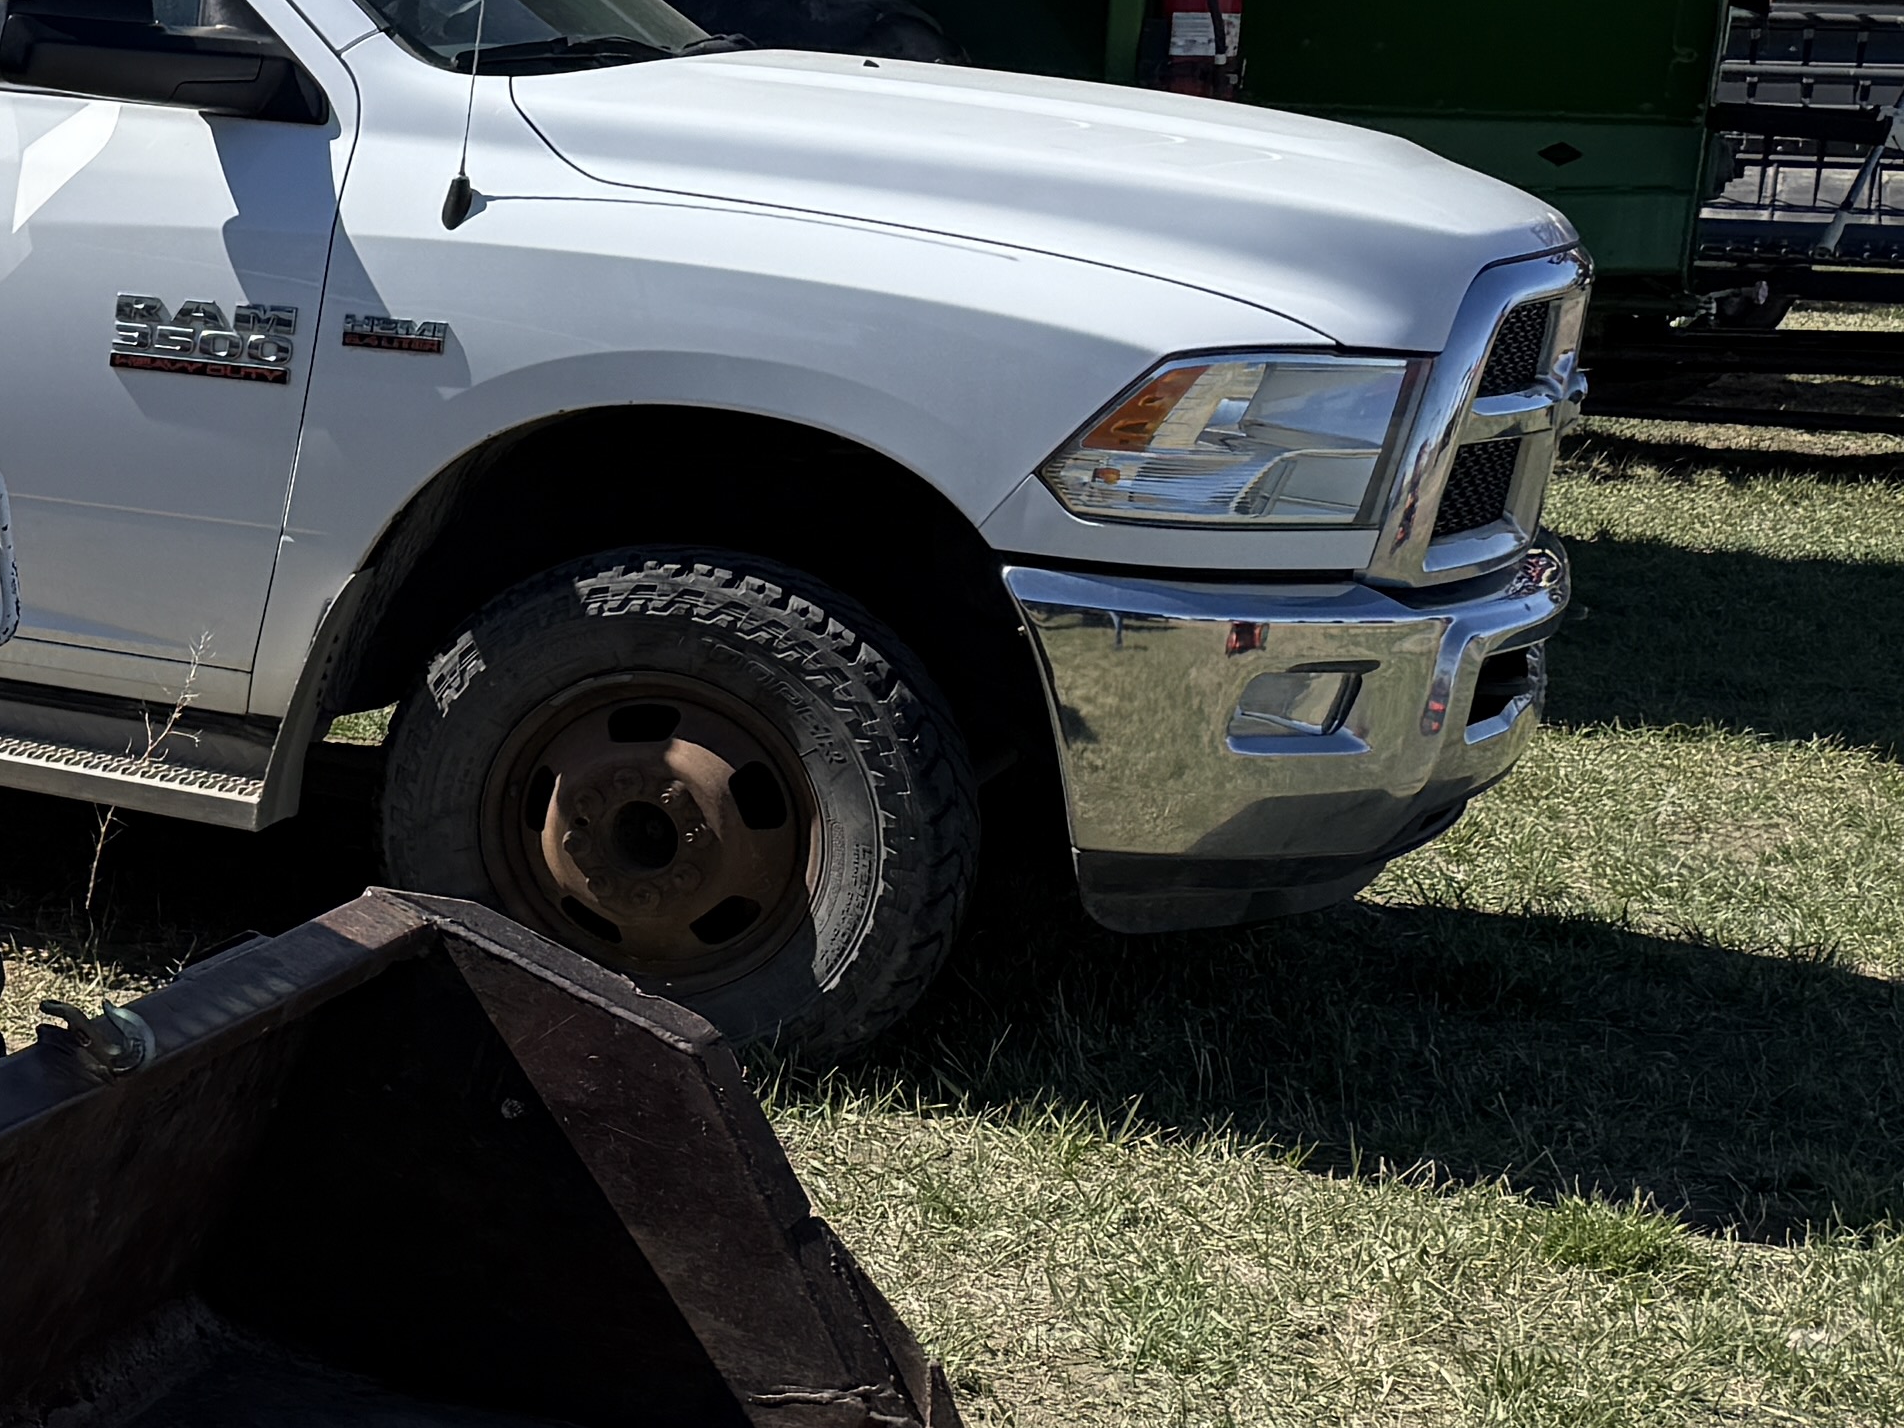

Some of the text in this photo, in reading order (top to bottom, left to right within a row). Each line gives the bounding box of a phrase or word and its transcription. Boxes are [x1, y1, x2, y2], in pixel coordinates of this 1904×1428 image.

[114, 291, 299, 336] RAM
[343, 313, 449, 339] HEMI
[111, 321, 293, 365] 3500
[344, 333, 439, 353] 6.4 LITER
[114, 354, 282, 382] HEAVY DUTY
[698, 633, 850, 767] OOPER
